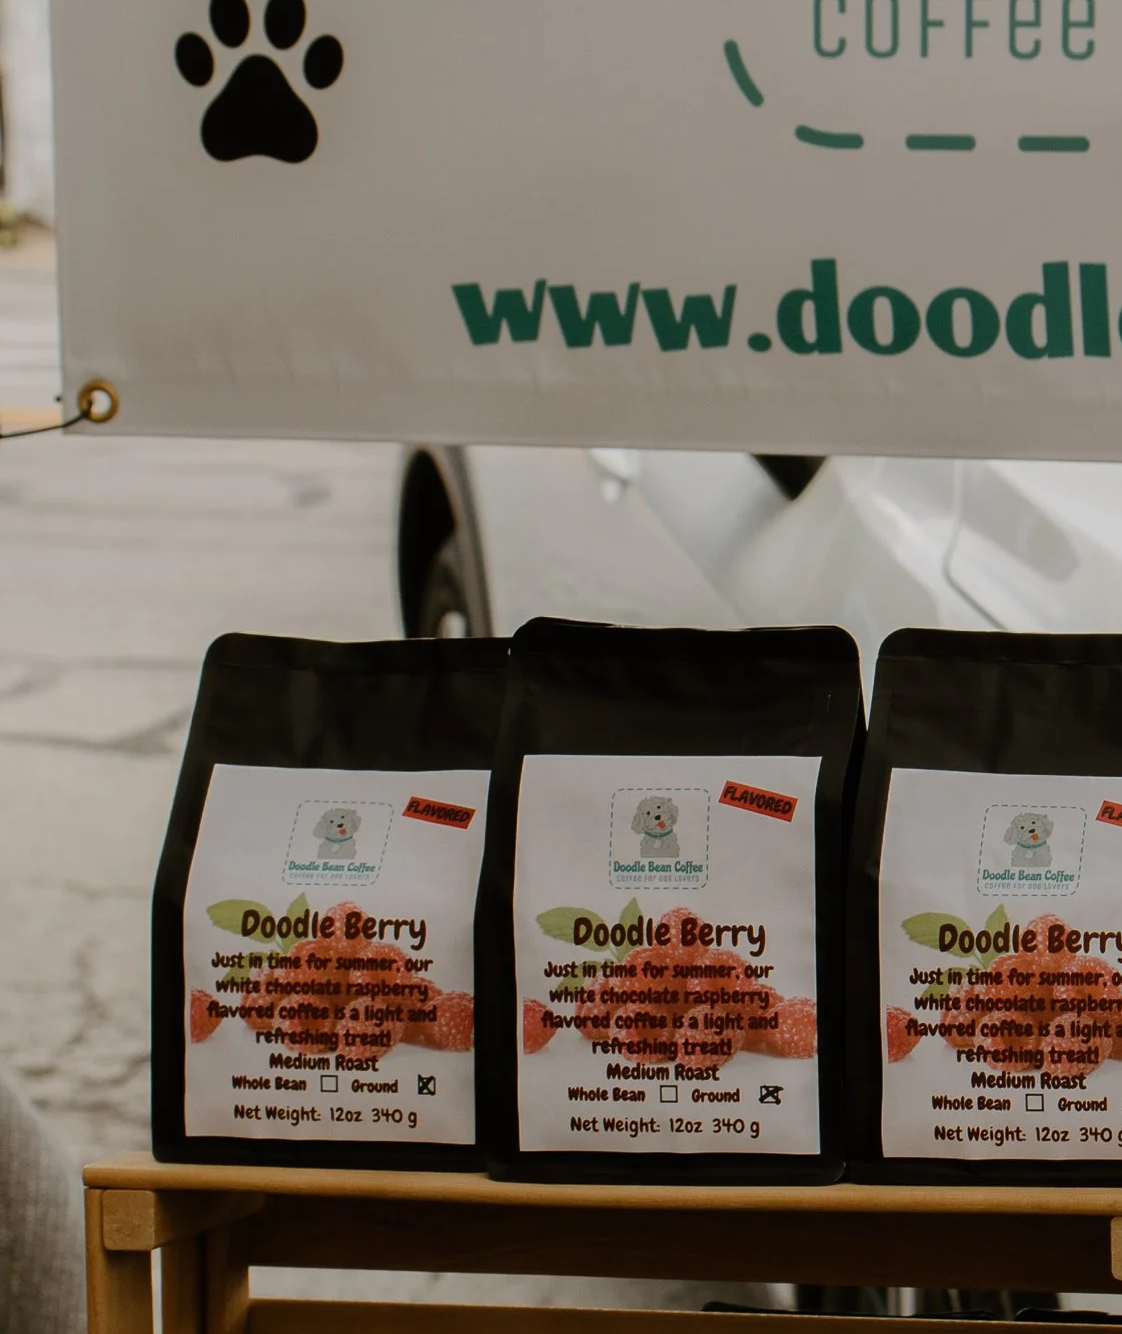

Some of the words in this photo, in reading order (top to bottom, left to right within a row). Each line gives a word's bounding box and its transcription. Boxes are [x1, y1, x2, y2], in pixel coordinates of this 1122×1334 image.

[722, 786, 793, 816] FLAVORED
[406, 800, 471, 825] FLAVORED
[613, 861, 646, 873] Doodle
[648, 861, 672, 873] Bean
[674, 861, 703, 874] Coffee
[982, 869, 1016, 881] Doodle
[1018, 870, 1042, 881] Bean
[1044, 869, 1075, 883] Coffee
[241, 909, 334, 939] Doodle
[345, 912, 426, 951] Berry
[573, 915, 671, 947] Doodle
[681, 918, 765, 957] Berry
[938, 922, 1037, 954] Doodle
[909, 968, 944, 985] Just
[948, 968, 962, 985] in
[966, 968, 1002, 986] time
[1008, 968, 1034, 986] for
[914, 993, 961, 1011] white
[966, 994, 1045, 1012] chocolate
[905, 1019, 975, 1037] flavored
[980, 1020, 1033, 1037] coffee
[1038, 1021, 1050, 1037] is
[1055, 1024, 1065, 1038] a
[1071, 1021, 1111, 1044] light
[269, 1053, 330, 1070] Medium
[335, 1054, 378, 1072] Roast
[957, 1045, 1044, 1070] refreshing
[1048, 1047, 1099, 1064] treat!
[971, 1071, 1035, 1089] Medium
[1040, 1072, 1086, 1090] Roast
[932, 1095, 973, 1110] Whole
[977, 1096, 1011, 1111] Bean
[1058, 1097, 1107, 1112] Ground
[570, 1117, 599, 1132] Net
[670, 1118, 703, 1133] 12oz
[713, 1118, 744, 1133] 340
[750, 1121, 759, 1139] g
[934, 1126, 963, 1142] Net
[1036, 1127, 1070, 1142] 12oz
[1080, 1127, 1112, 1142] 340
